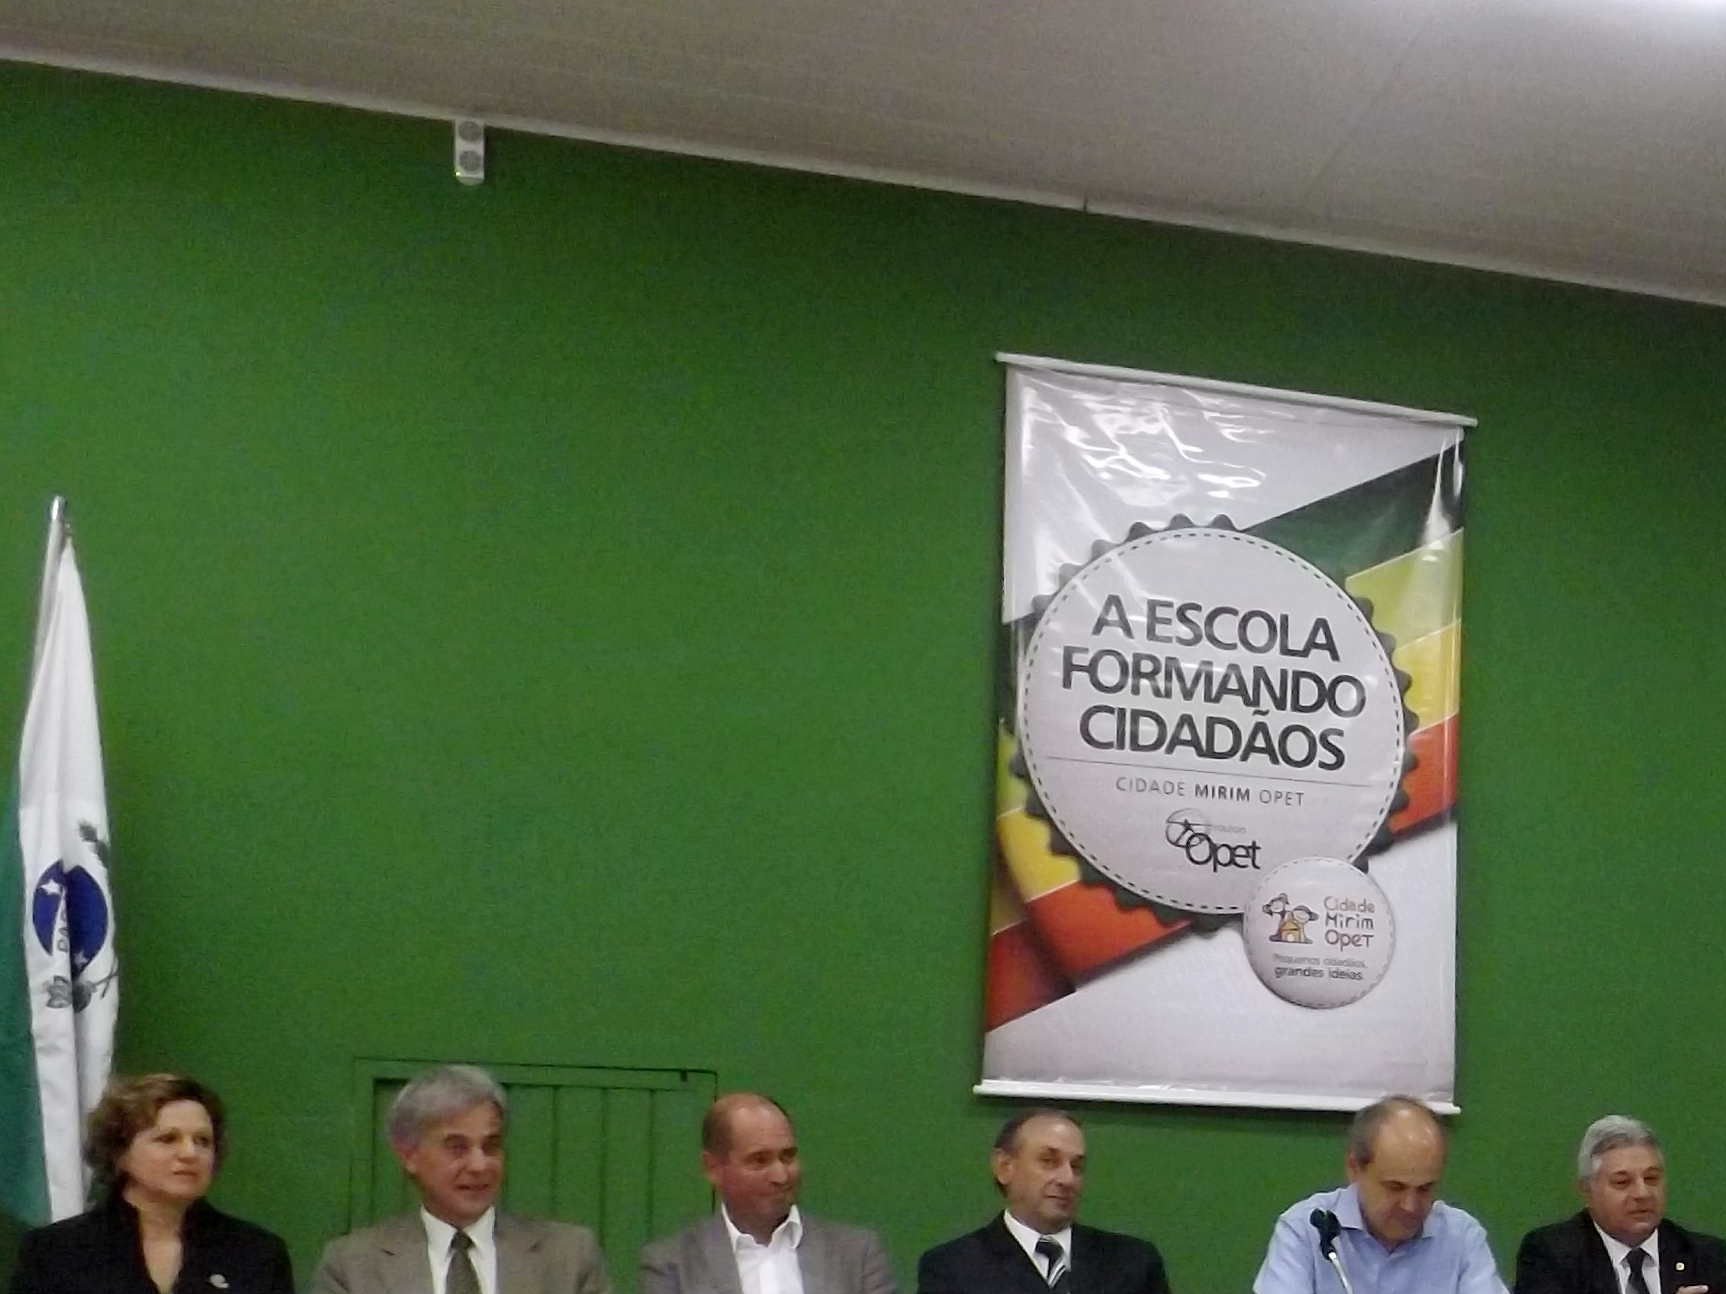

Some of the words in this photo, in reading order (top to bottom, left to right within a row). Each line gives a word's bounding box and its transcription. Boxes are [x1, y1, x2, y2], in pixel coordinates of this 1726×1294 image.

[1092, 594, 1134, 640] A
[1147, 599, 1341, 663] ESCOLA
[1062, 646, 1366, 718] FORMANDO
[1079, 705, 1346, 772] CIDADÃOS
[1115, 776, 1186, 797] CIDADE
[1194, 783, 1251, 802] MIRIM
[1258, 789, 1305, 807] OPET
[1185, 832, 1262, 873] Opet
[1323, 896, 1375, 914] Cidade
[1325, 914, 1374, 930] Mirim
[1274, 966, 1324, 979] grandes
